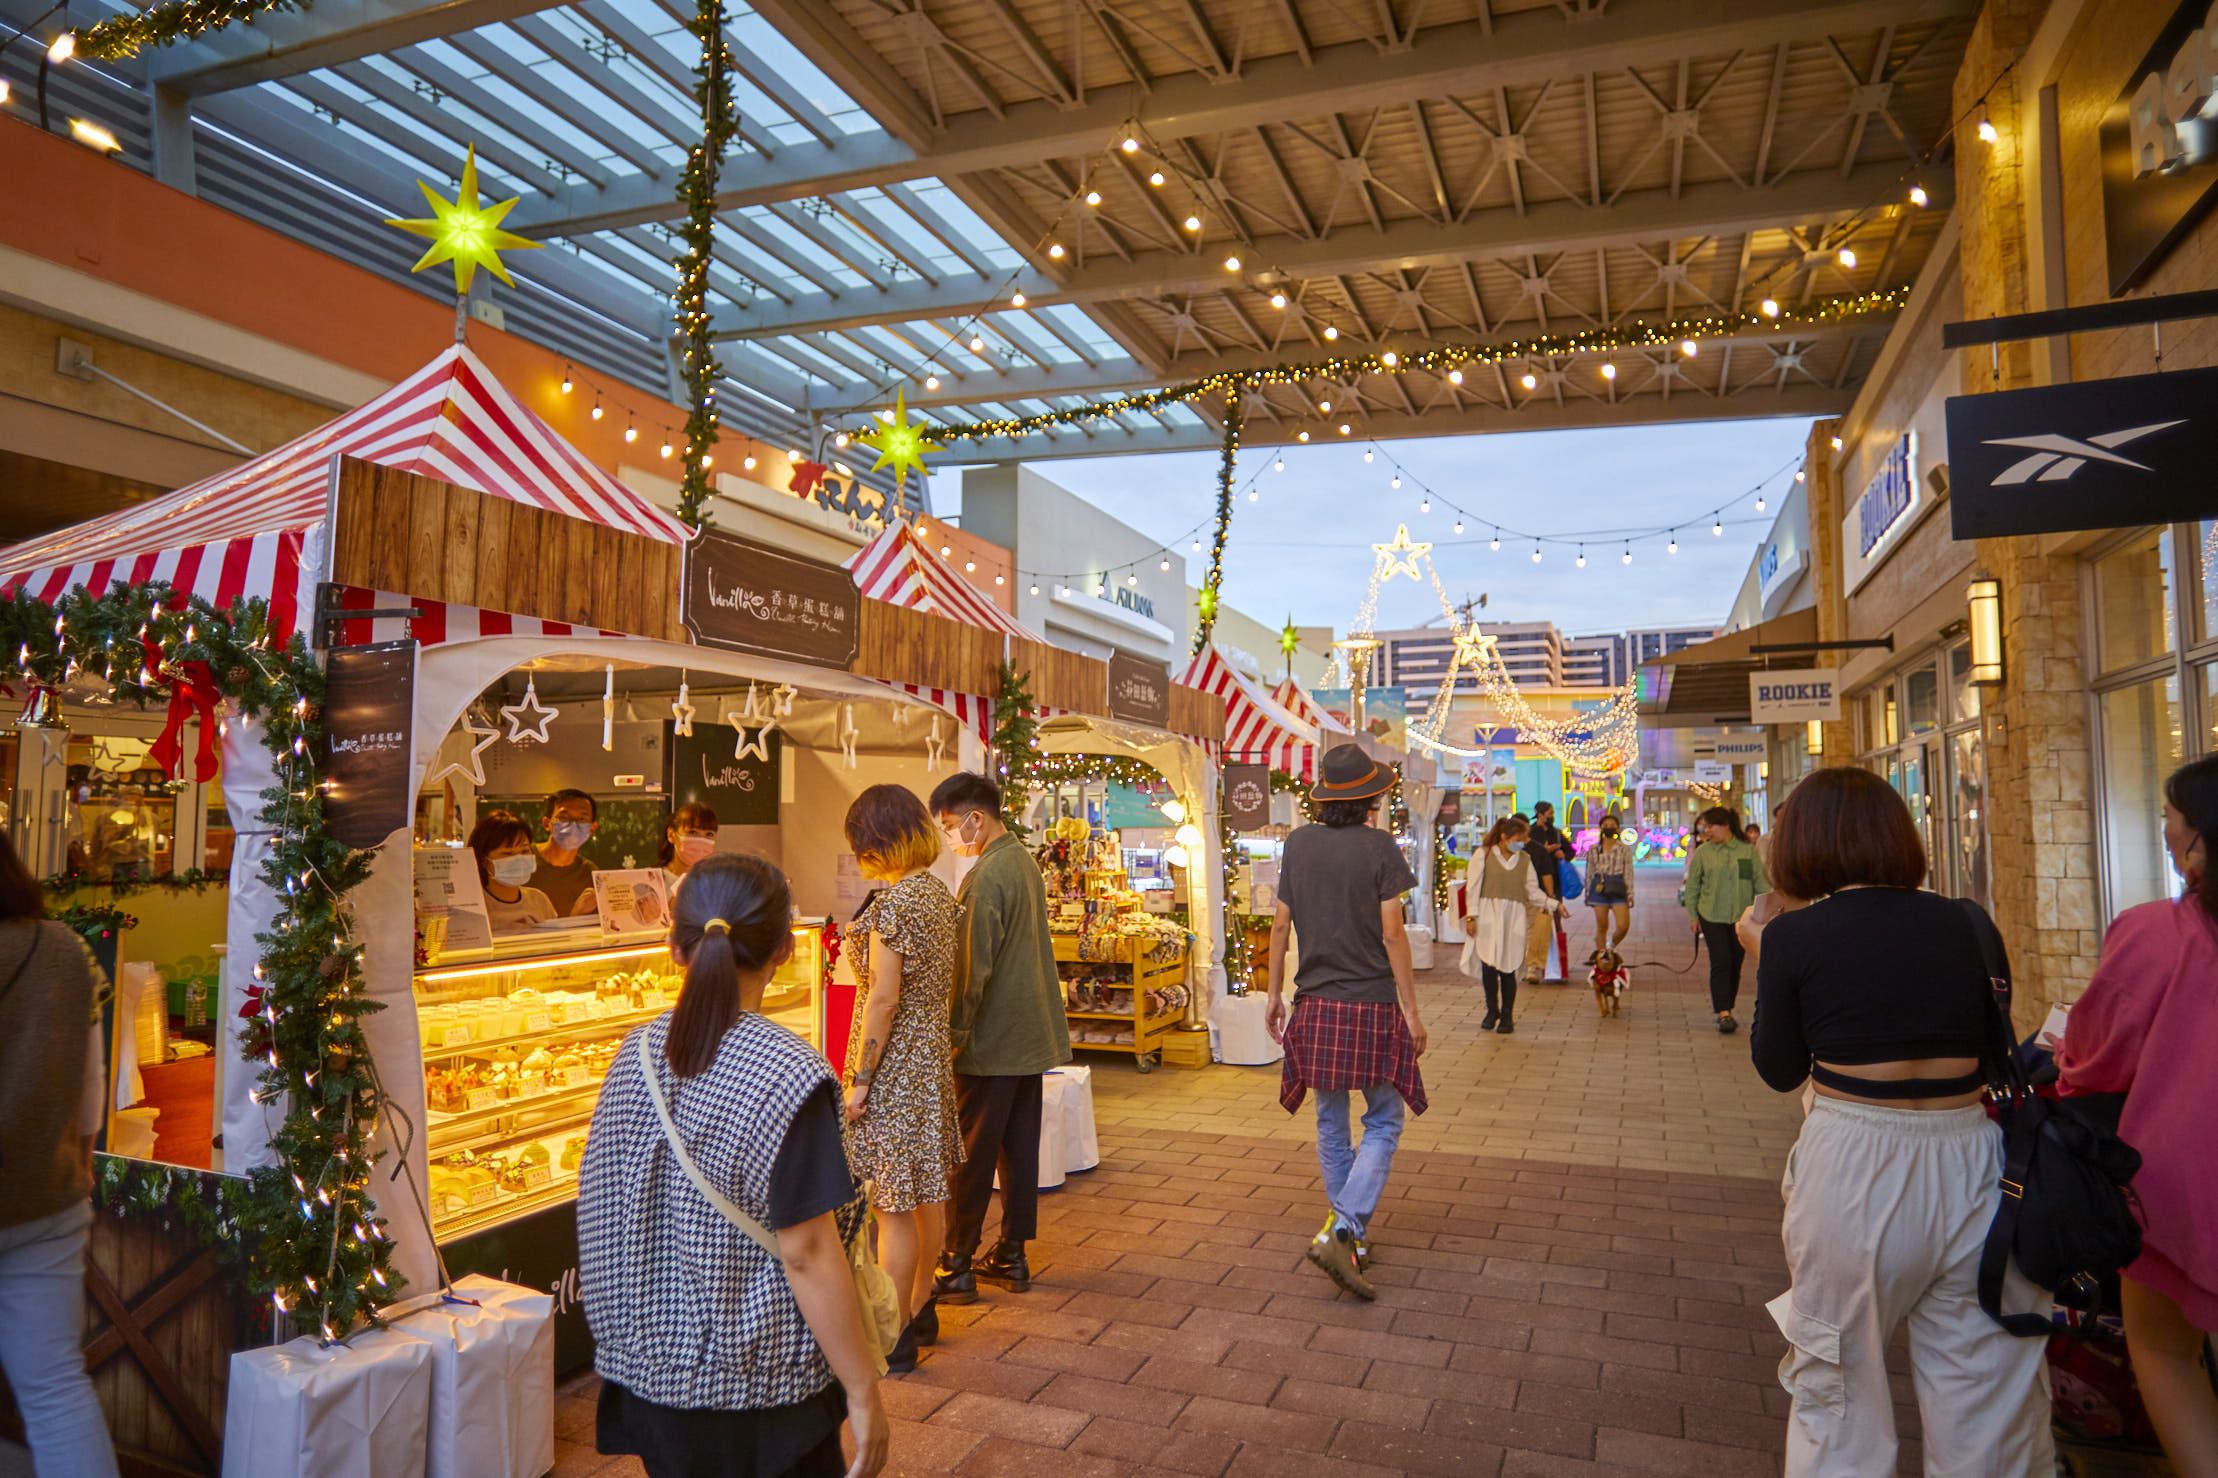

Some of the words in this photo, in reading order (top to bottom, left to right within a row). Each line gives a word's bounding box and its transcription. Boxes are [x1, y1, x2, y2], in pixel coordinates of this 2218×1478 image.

[708, 566, 770, 620] Vanilla
[1758, 682, 1832, 702] ROOKIE
[1717, 743, 1764, 753] PHILIPS
[703, 752, 755, 791] Vanilla
